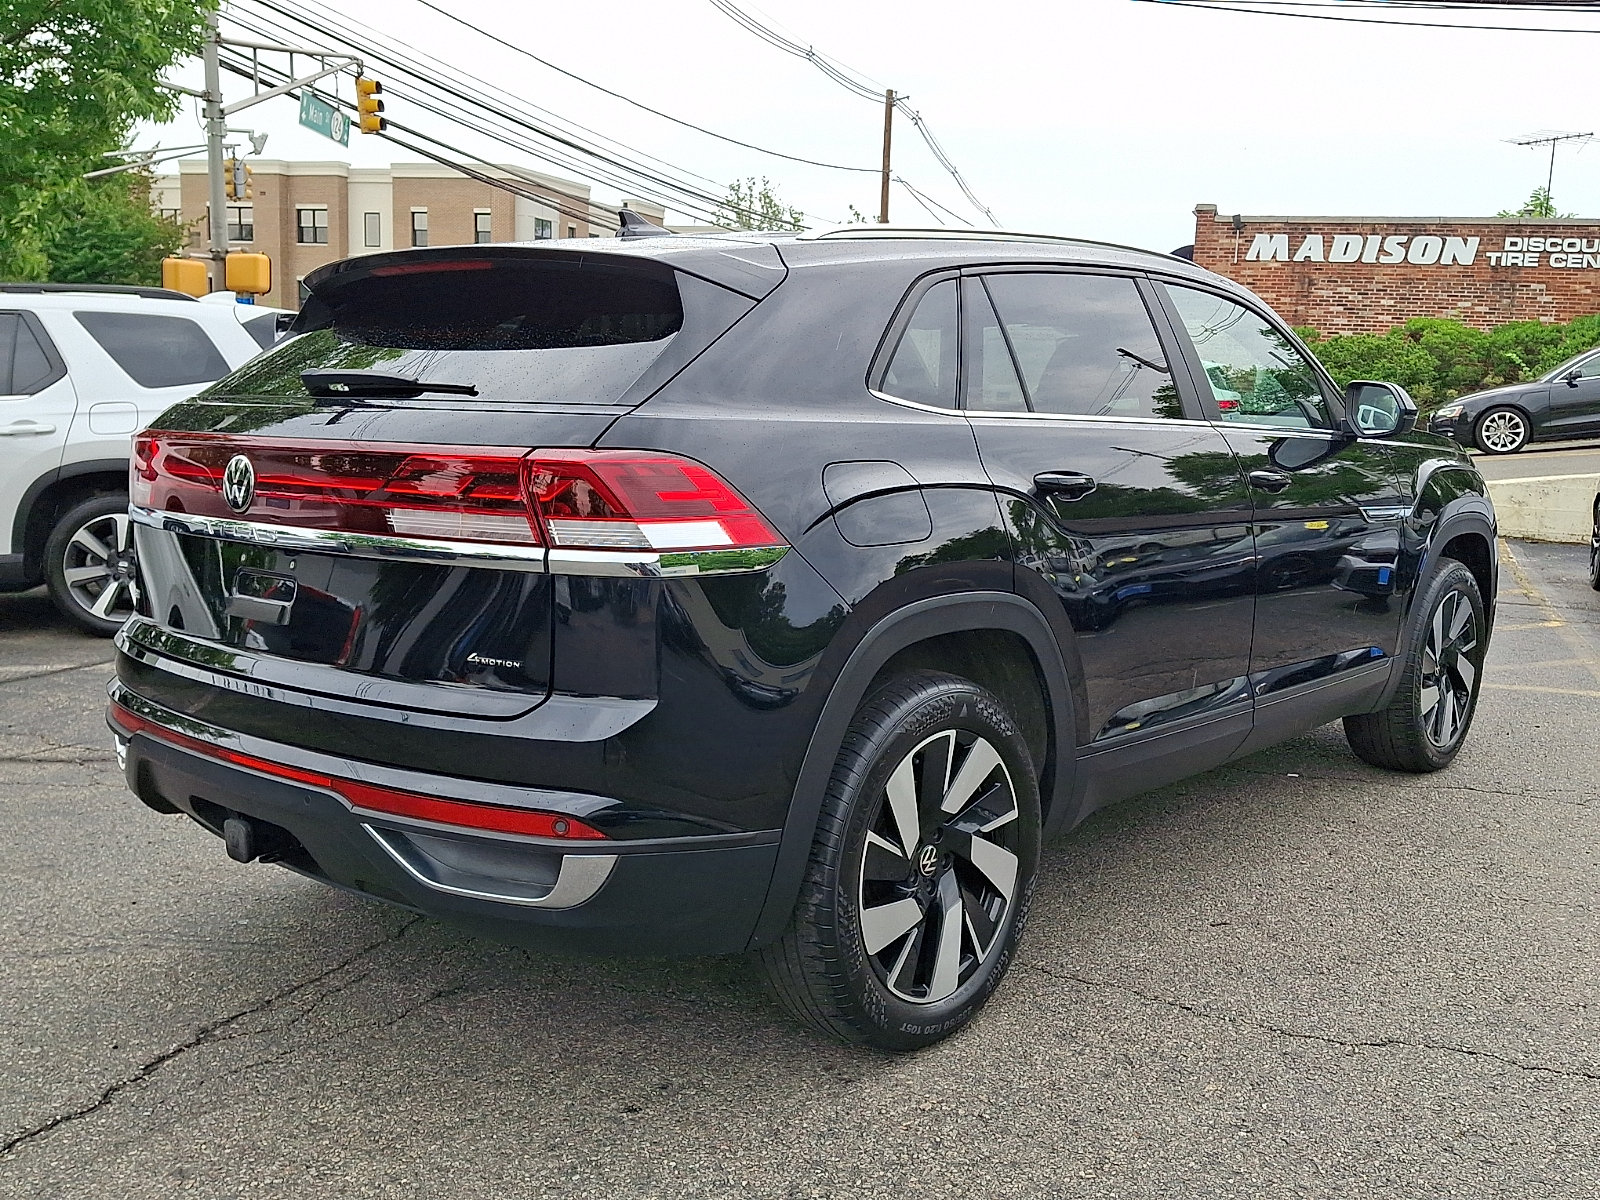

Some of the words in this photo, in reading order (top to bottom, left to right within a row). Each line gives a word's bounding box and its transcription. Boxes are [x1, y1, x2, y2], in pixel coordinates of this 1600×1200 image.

[309, 103, 323, 126] Main
[1245, 233, 1480, 266] MADISON
[1503, 236, 1600, 253] DISCOU
[1485, 251, 1540, 267] TIRE
[467, 652, 521, 668] 4MOTION
